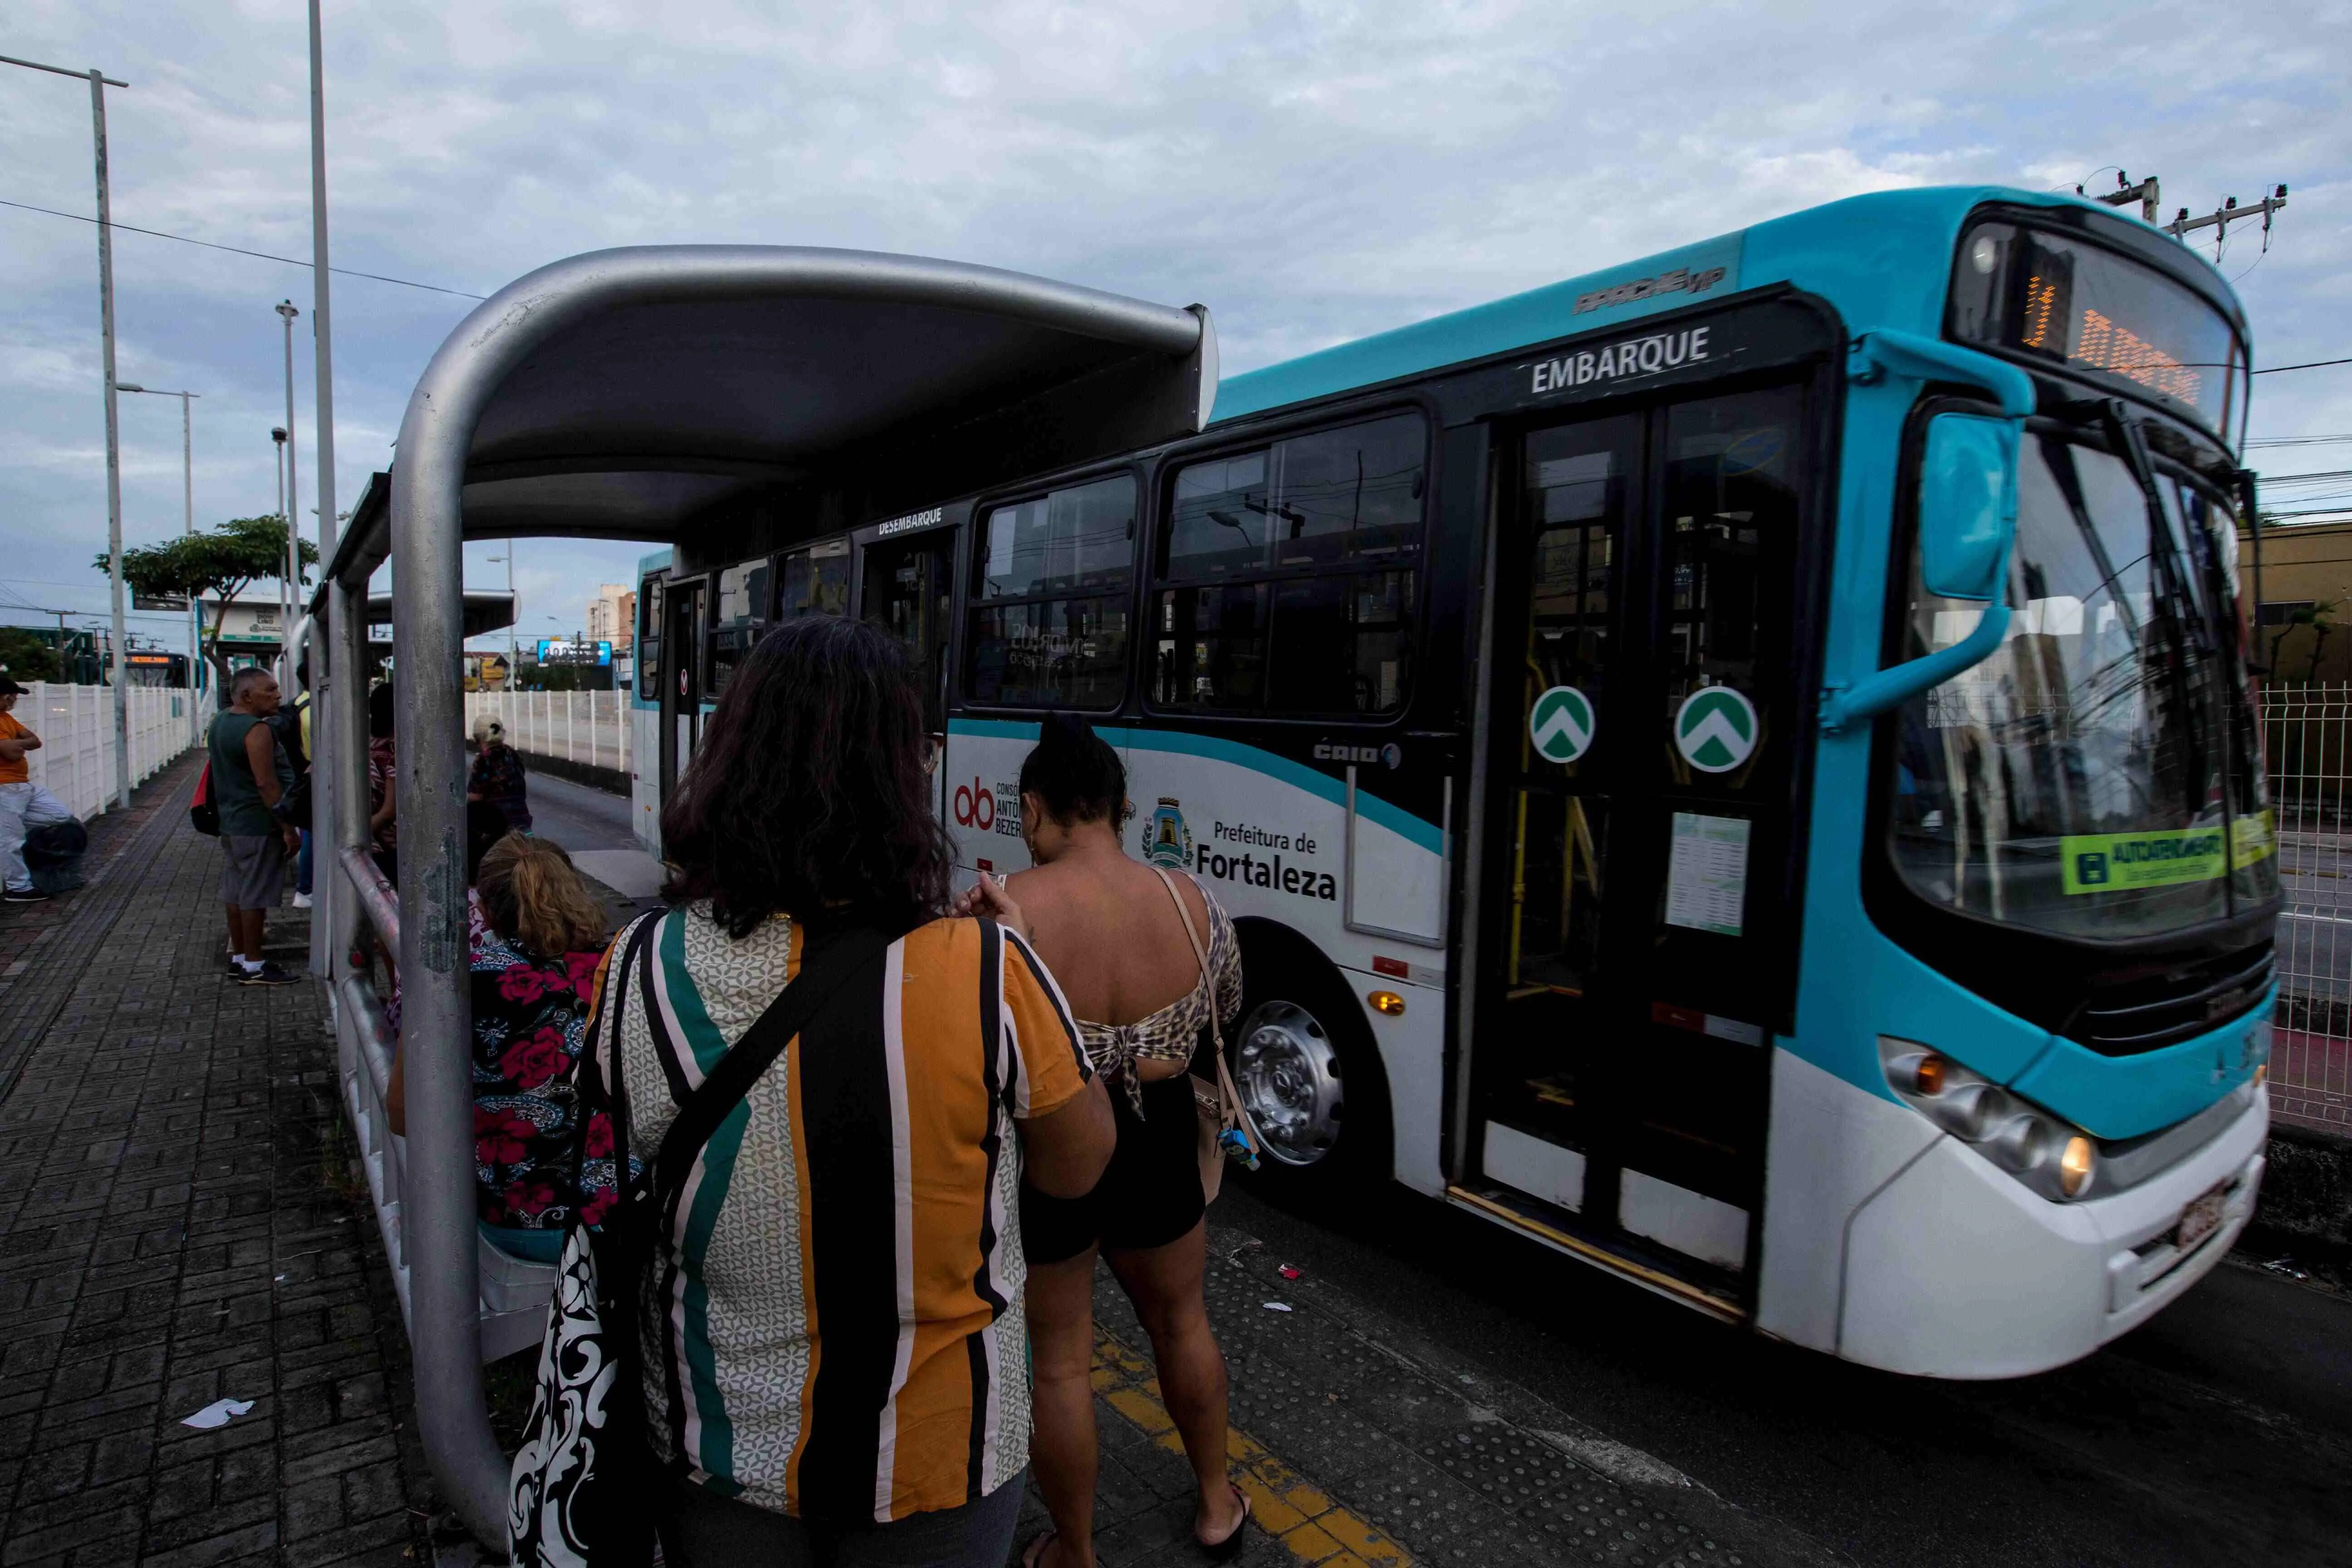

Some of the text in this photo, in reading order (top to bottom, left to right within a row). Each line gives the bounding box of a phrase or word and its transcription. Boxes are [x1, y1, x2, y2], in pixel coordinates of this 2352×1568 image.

[1531, 326, 1710, 393] EMBARQUE
[879, 507, 942, 535] DESEMBARQUE
[1313, 744, 1378, 763] CAIO
[995, 817, 1024, 838] BEZER
[1214, 821, 1317, 854] Prefeitura de
[1197, 843, 1336, 902] Fortaleza
